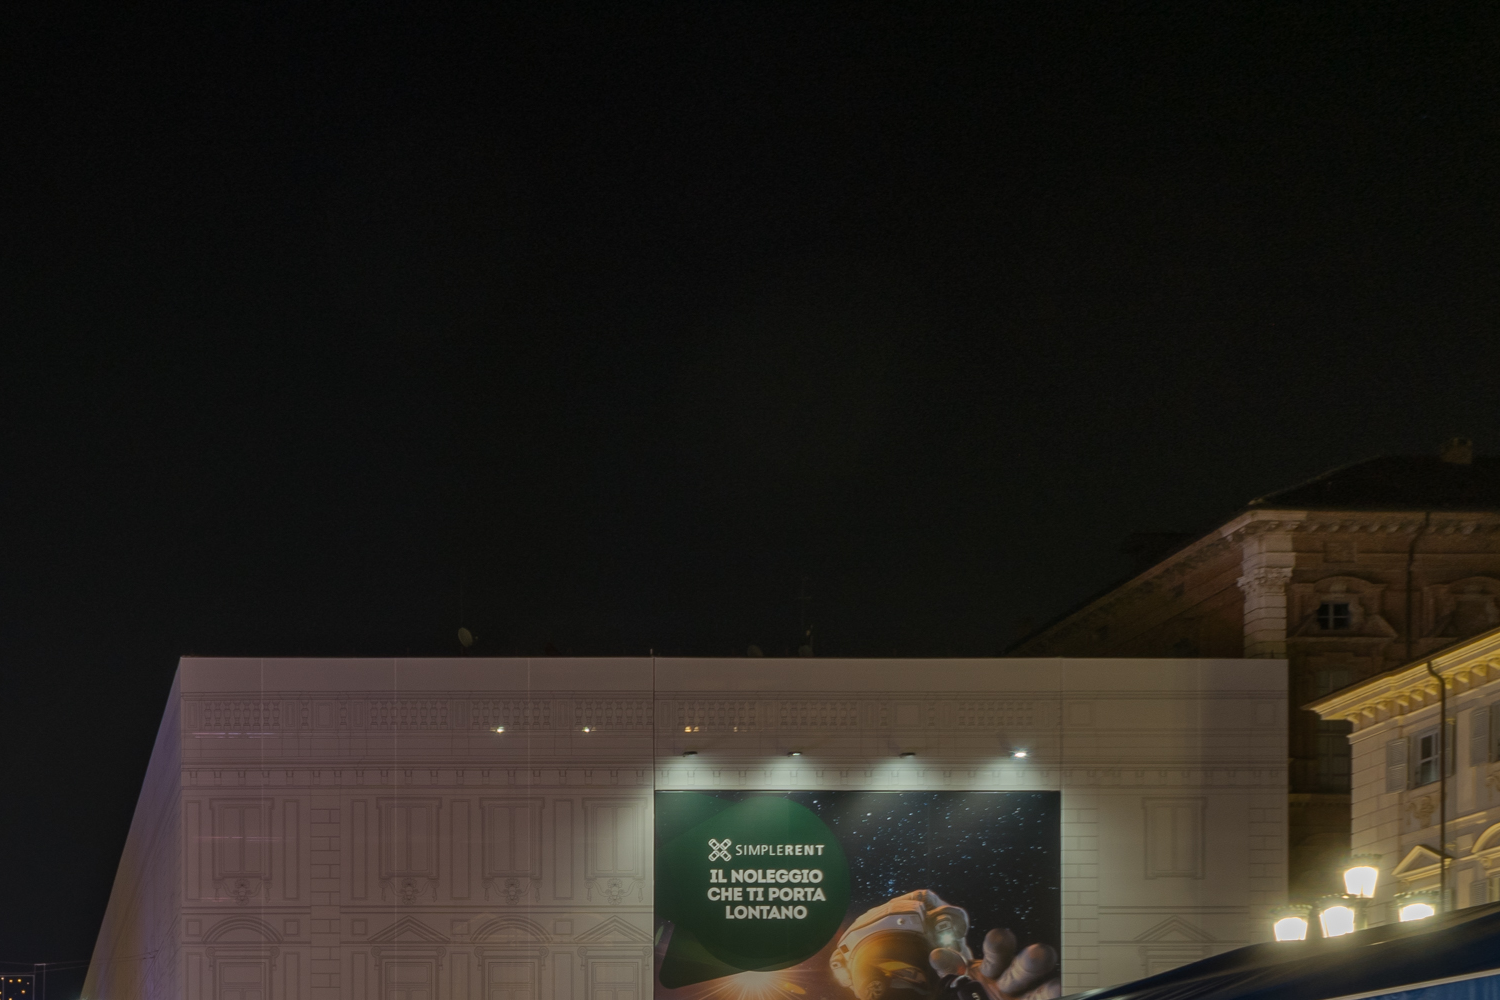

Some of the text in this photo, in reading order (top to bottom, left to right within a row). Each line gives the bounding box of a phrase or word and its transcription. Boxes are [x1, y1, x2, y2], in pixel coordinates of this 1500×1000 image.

[735, 844, 825, 856] SIMPLERENT
[709, 869, 823, 884] IL NOLEGGIO
[707, 887, 827, 901] CHE TI PORTA
[725, 905, 808, 920] LONTANO
